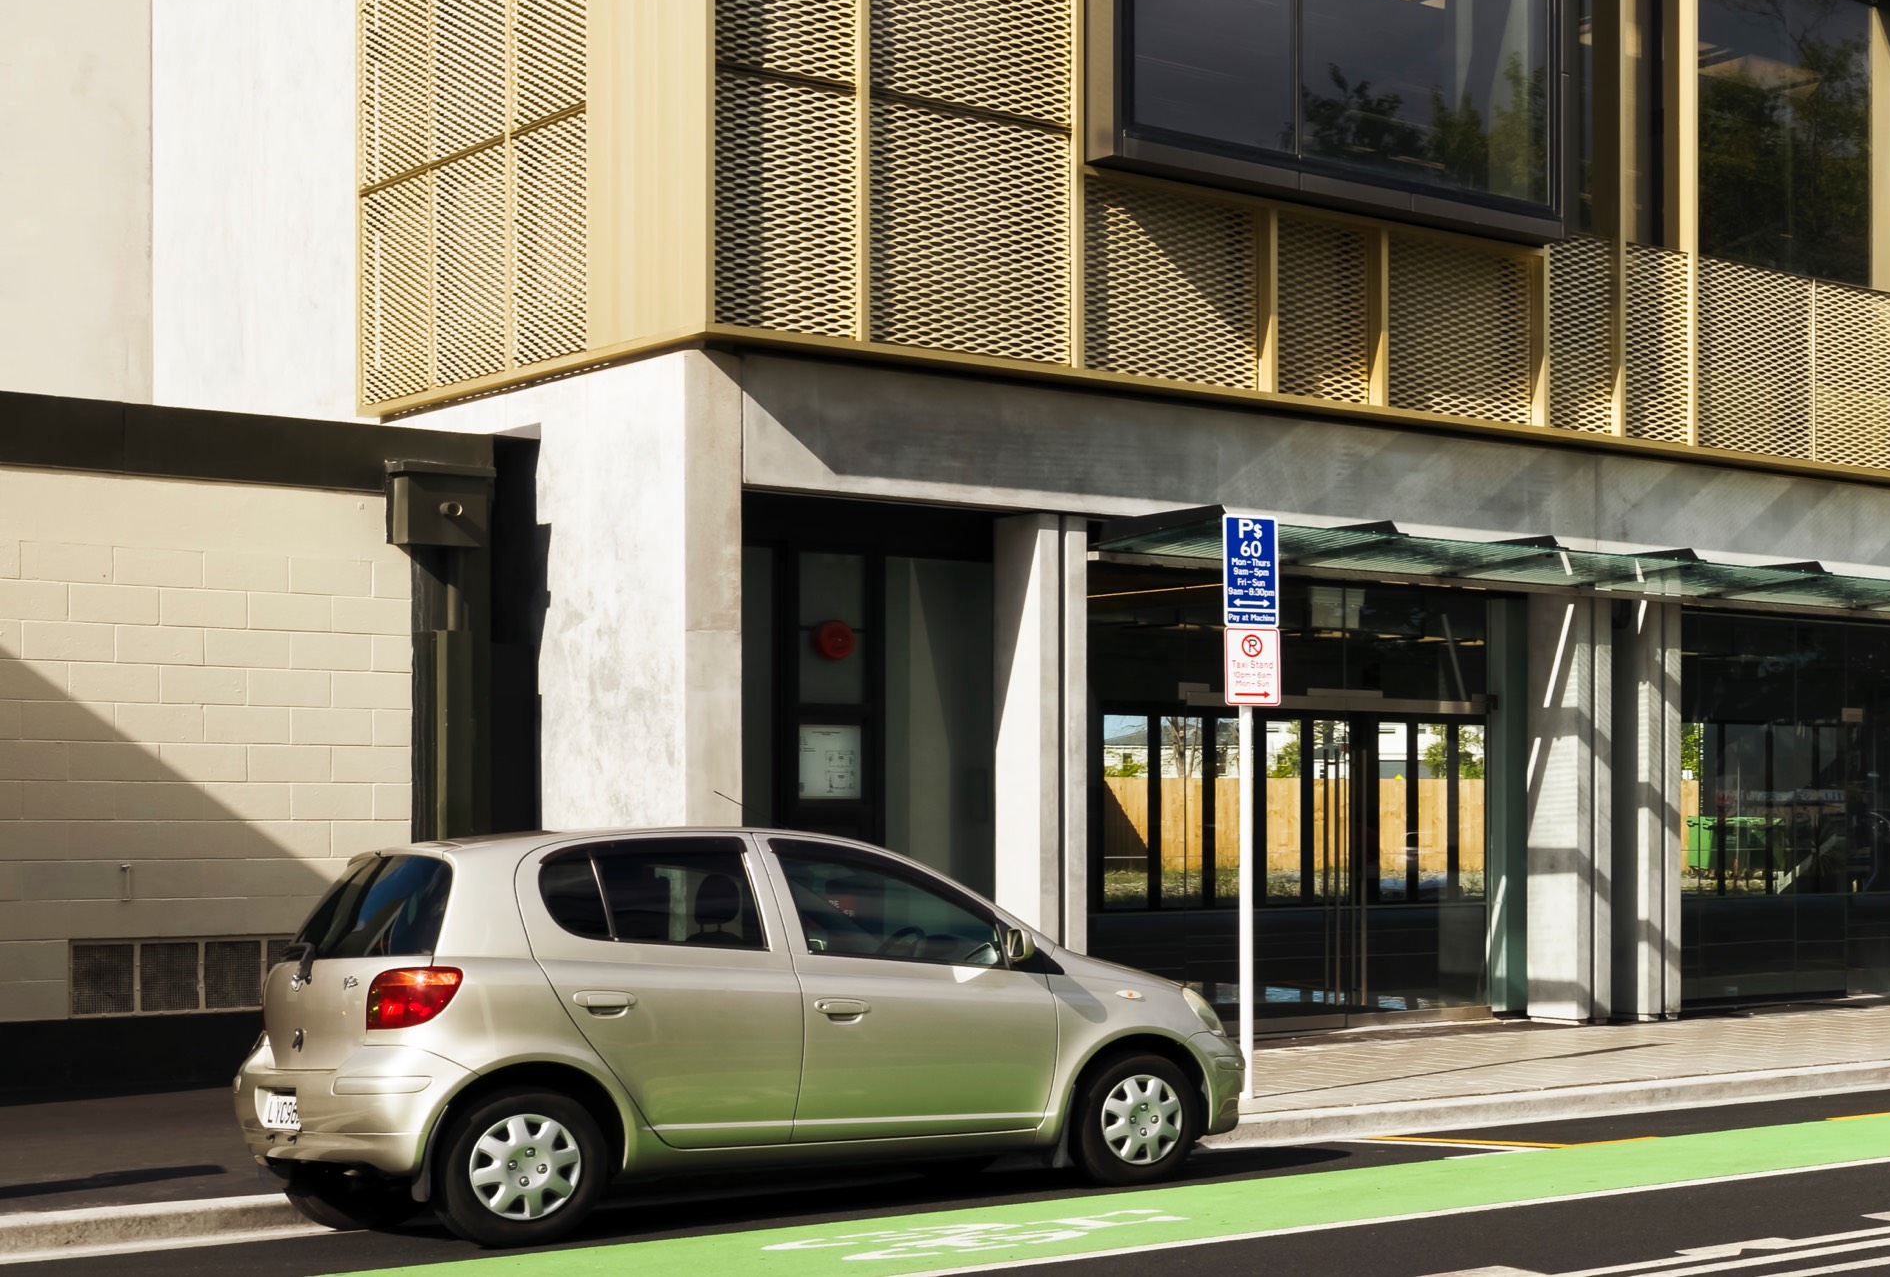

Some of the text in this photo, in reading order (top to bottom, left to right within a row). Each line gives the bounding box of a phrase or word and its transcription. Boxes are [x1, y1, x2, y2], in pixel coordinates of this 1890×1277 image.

[1238, 518, 1263, 540] P$
[1240, 540, 1262, 557] 60
[1228, 613, 1240, 622] Pay
[1250, 614, 1275, 622] Machine
[1232, 659, 1274, 669] Taxi Stand
[267, 1101, 300, 1124] LYC96
